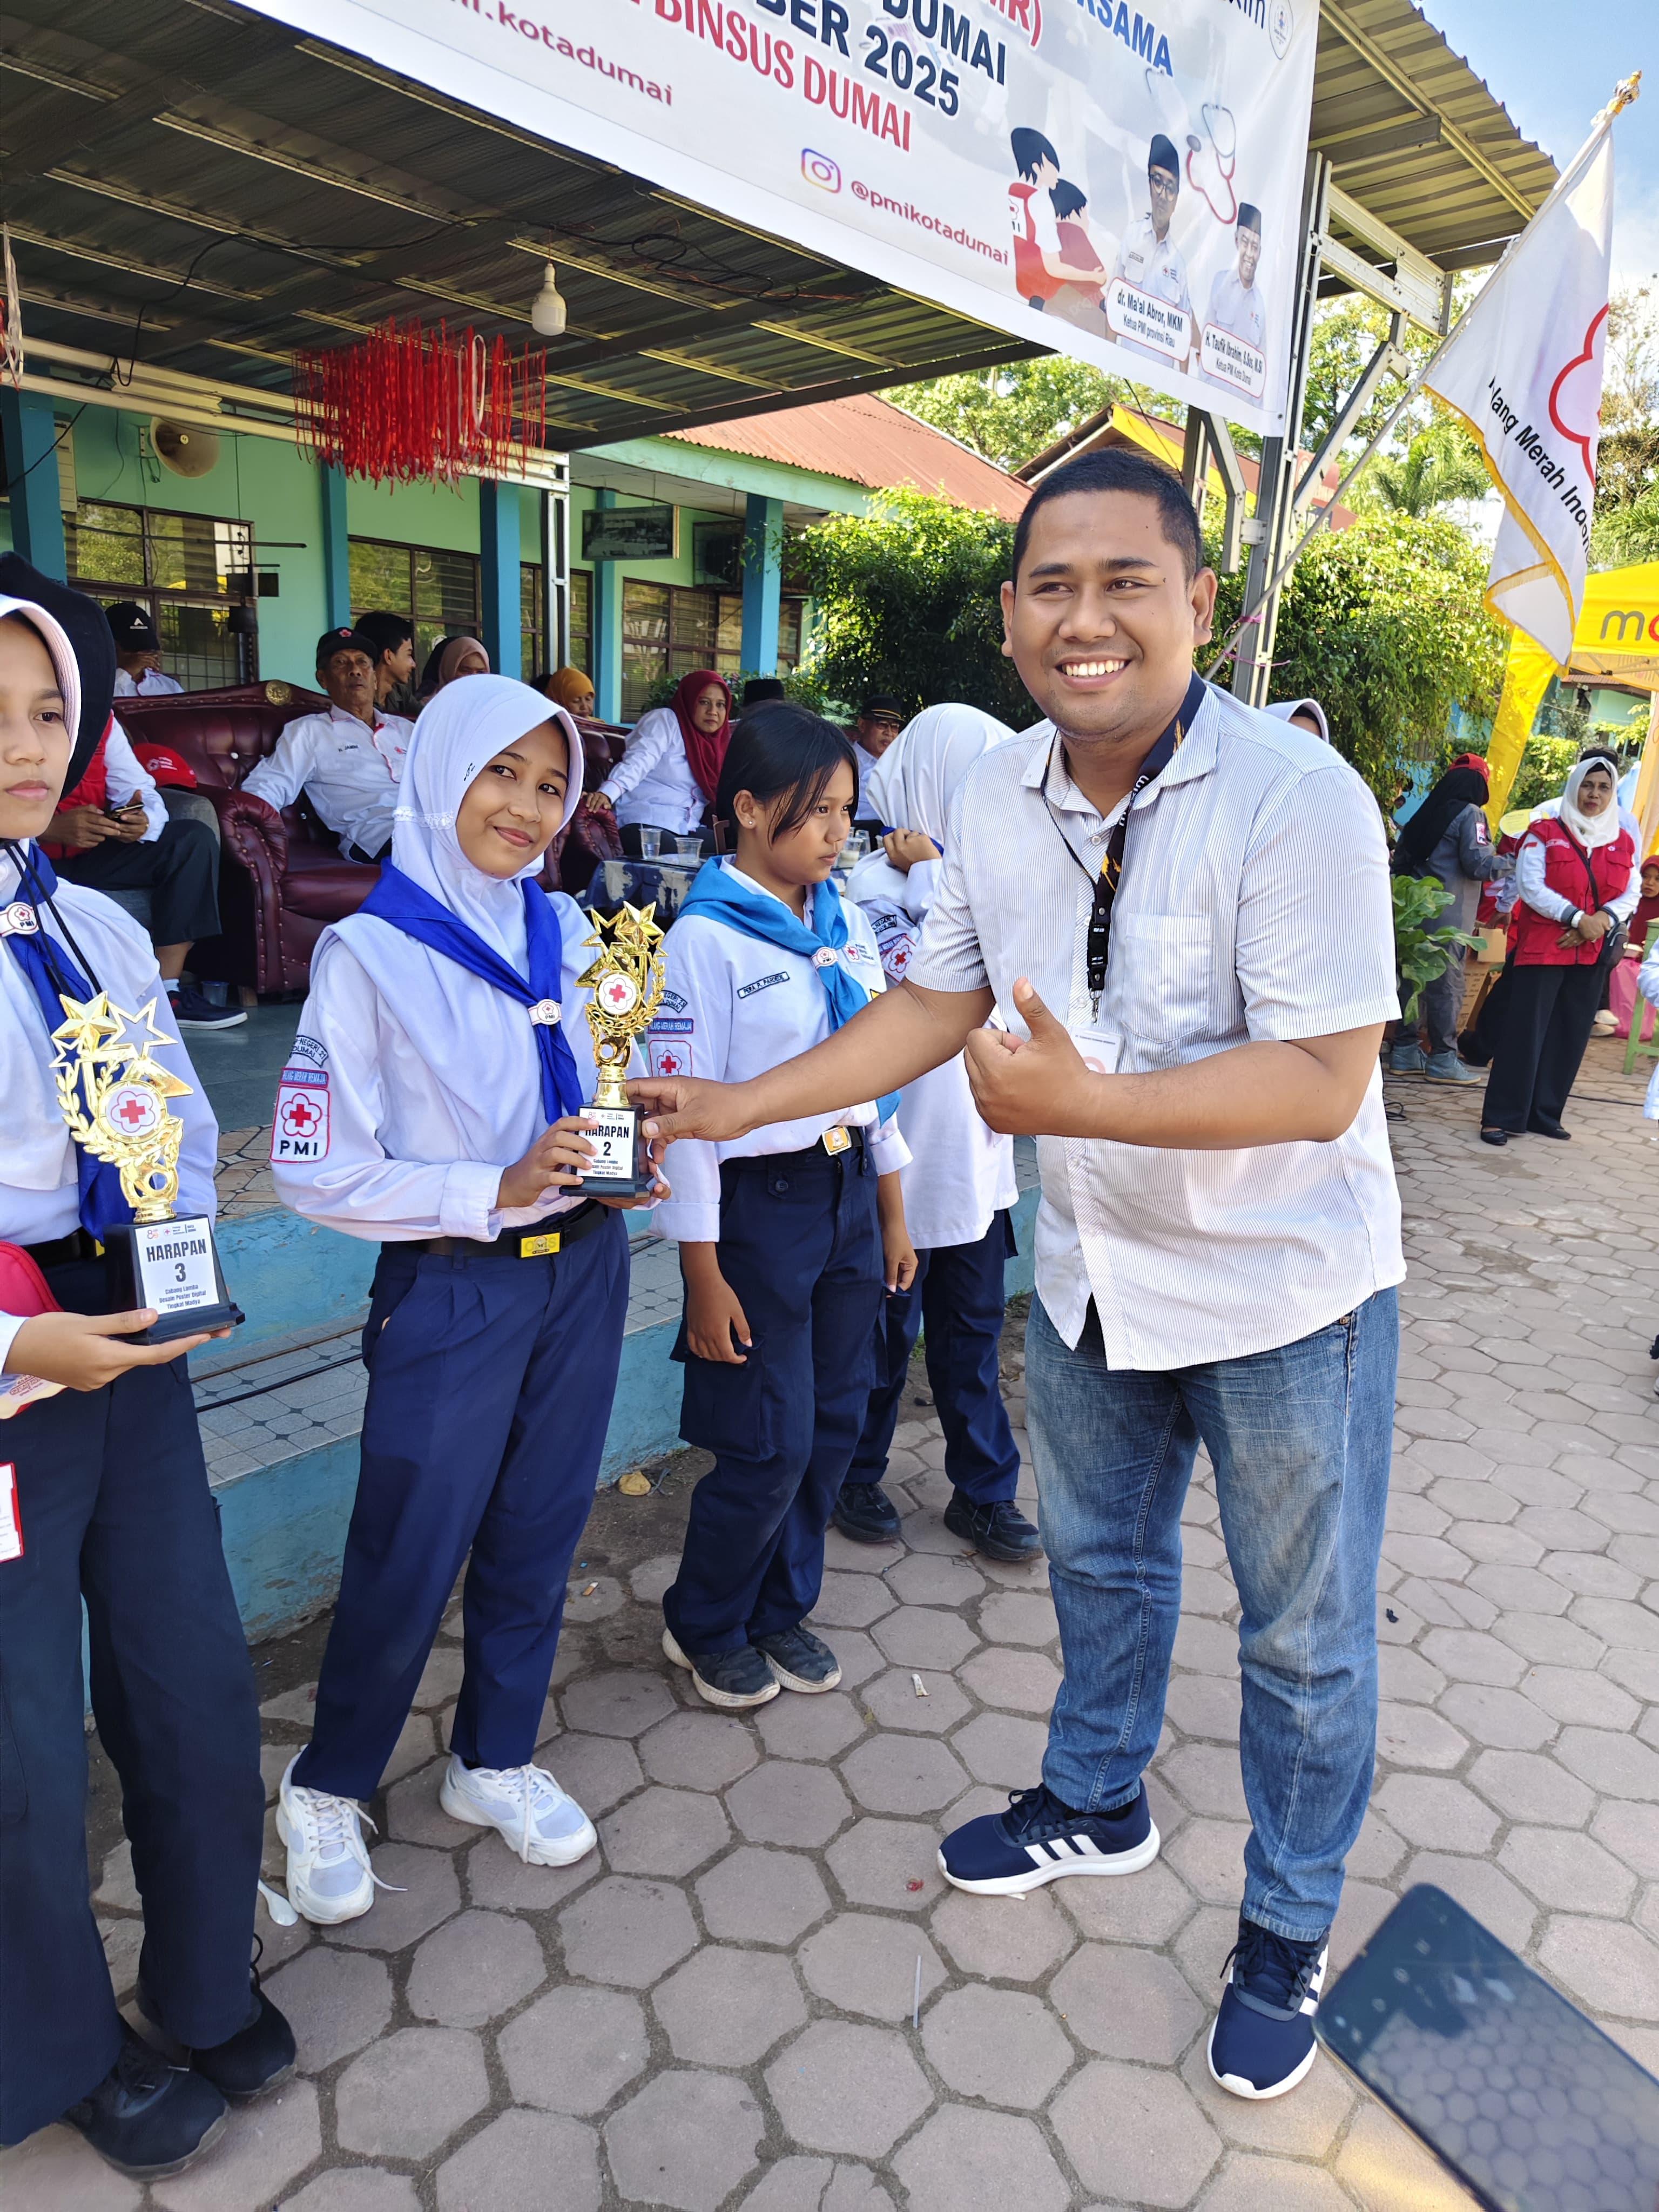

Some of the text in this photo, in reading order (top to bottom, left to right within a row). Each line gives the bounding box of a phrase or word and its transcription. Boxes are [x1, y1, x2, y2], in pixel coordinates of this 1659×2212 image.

[865, 25, 959, 116] 2025
[804, 56, 911, 152] DUMAI
[851, 181, 1009, 266] @pmikotadumai
[1117, 288, 1125, 307] dr.
[1128, 293, 1145, 315] Ma'al
[1167, 311, 1183, 332] MKM
[1514, 425, 1565, 490] Merah
[664, 992, 679, 1002] EGERI
[299, 1038, 320, 1053] NEGERI
[279, 1141, 318, 1156] PMI
[603, 1141, 611, 1156] 2
[146, 1239, 207, 1262] HARAPAN
[174, 1263, 186, 1283] 3
[165, 1286, 183, 1294] Cabang
[192, 1290, 206, 1298] Digital
